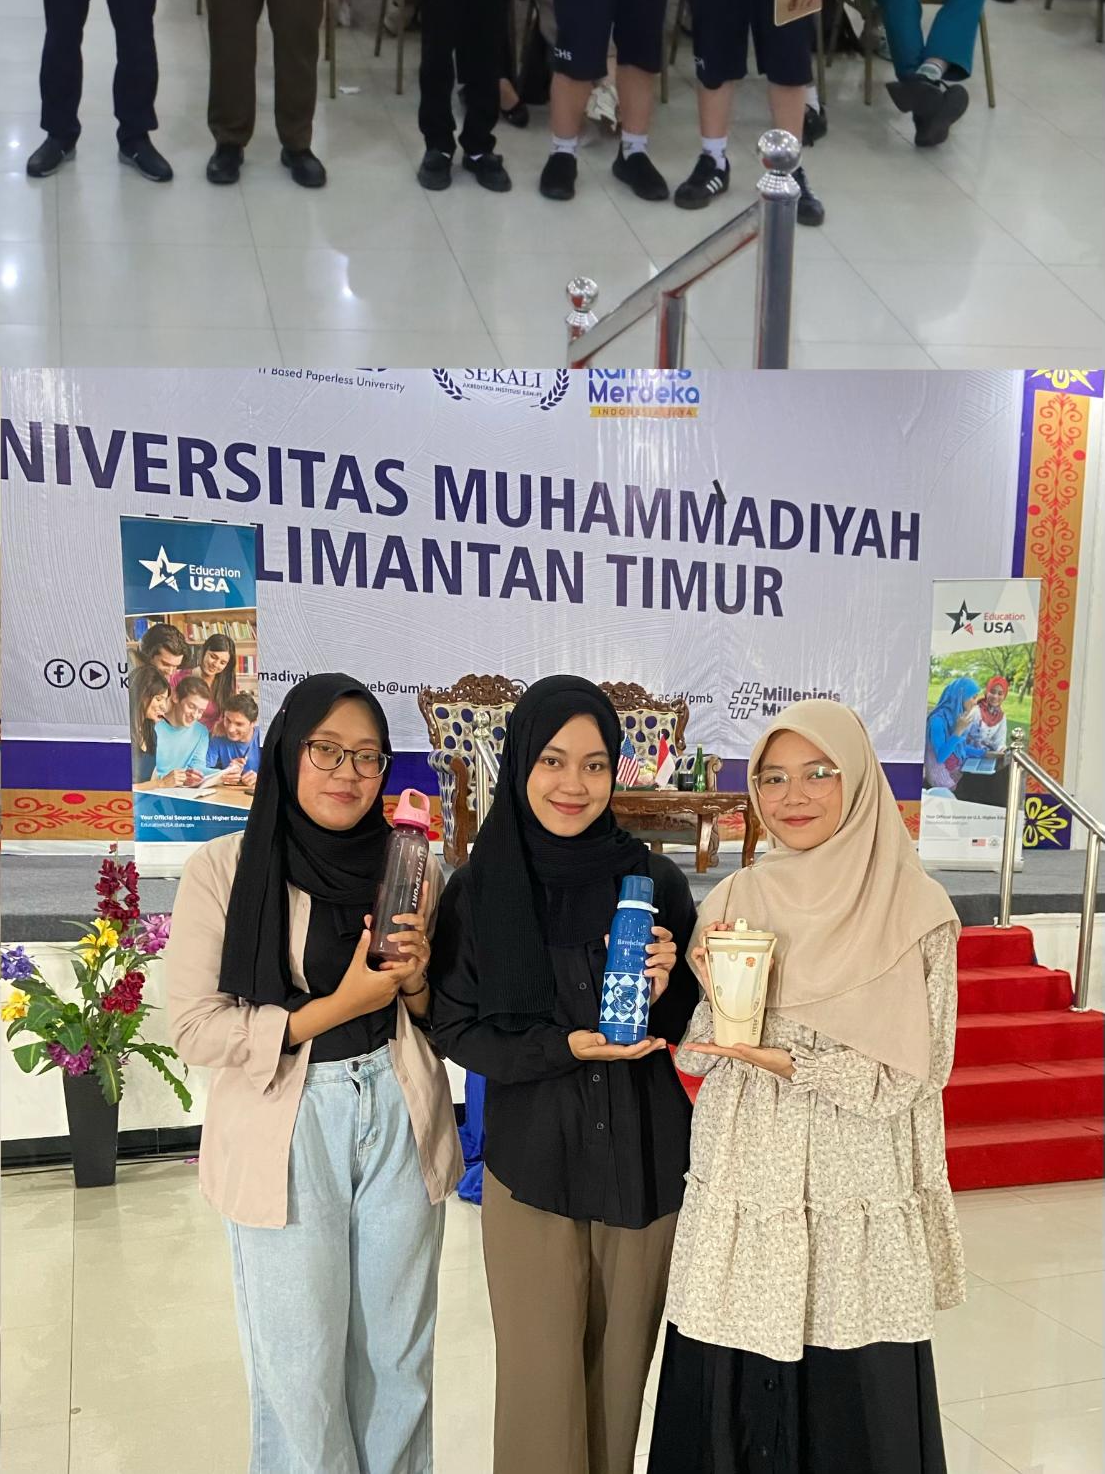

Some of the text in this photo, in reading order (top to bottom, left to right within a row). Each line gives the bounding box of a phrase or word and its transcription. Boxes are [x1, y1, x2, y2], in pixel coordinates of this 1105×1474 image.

[271, 368, 303, 379] Based
[306, 370, 354, 385] Paperless
[357, 376, 405, 394] University
[462, 383, 494, 392] AKREDITASI
[464, 369, 542, 388] SEKALI
[588, 380, 700, 403] Merdeka
[1, 418, 921, 561] NIVERSITAS MUHAMMADIYAH
[144, 513, 785, 618] LIMANTAN TIMUR
[189, 565, 241, 579] Education
[189, 576, 230, 594] USA
[983, 612, 1026, 621] Education
[983, 622, 1015, 634] USA
[411, 861, 424, 909] FITSPORT
